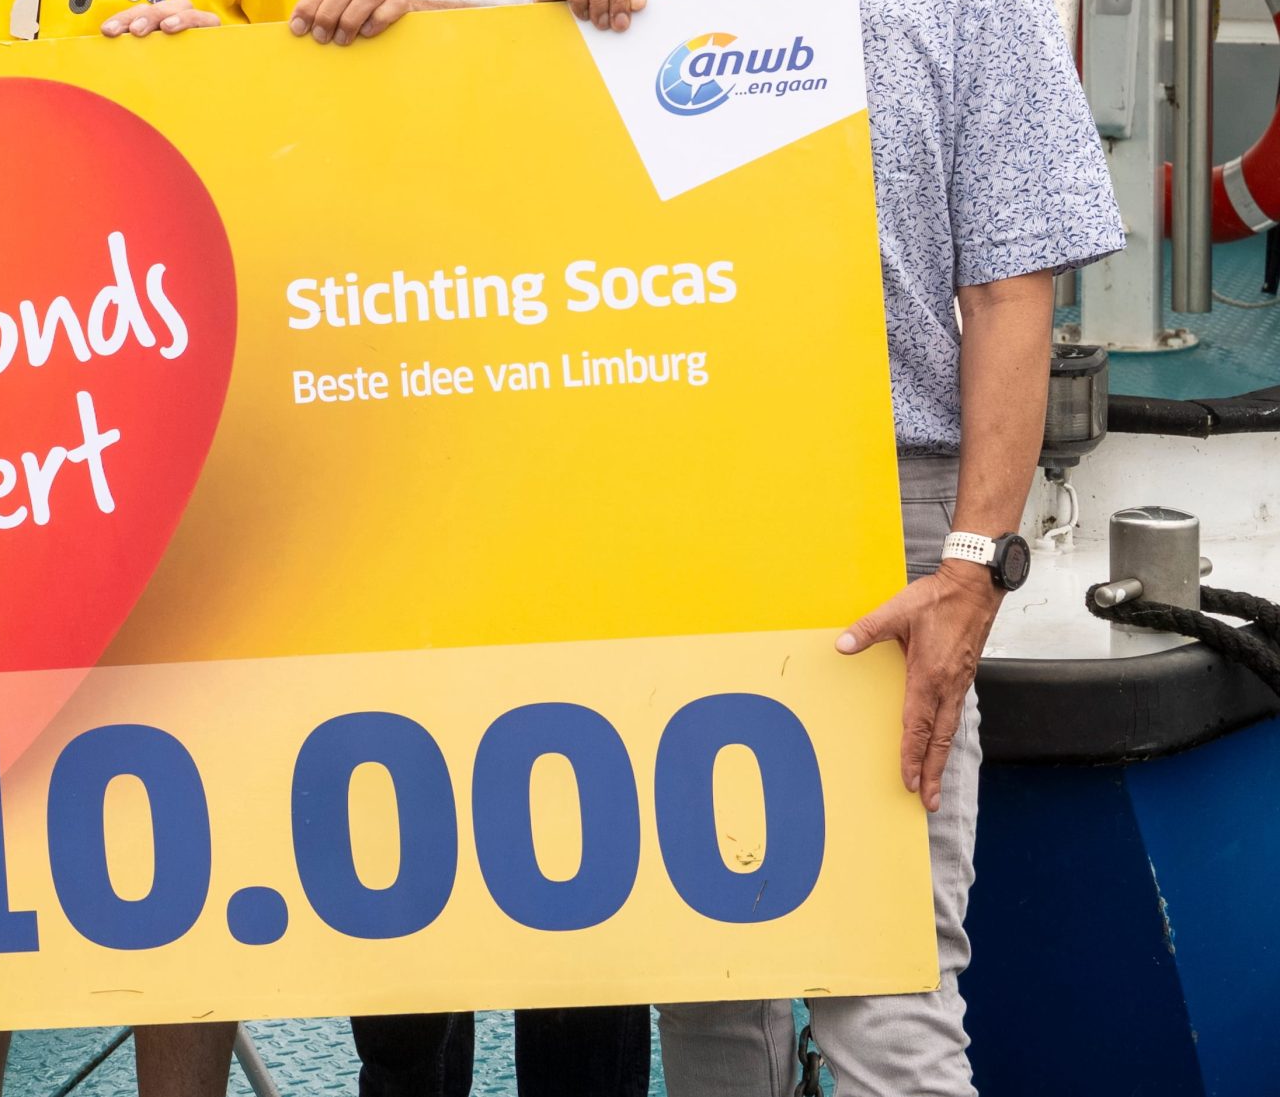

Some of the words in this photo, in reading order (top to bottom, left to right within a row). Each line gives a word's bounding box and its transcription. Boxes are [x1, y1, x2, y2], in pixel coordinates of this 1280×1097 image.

[688, 35, 815, 78] anwb
[775, 77, 828, 97] gaan
[285, 265, 548, 330] Stichting
[564, 259, 737, 313] Socas
[292, 367, 389, 404] Beste
[400, 361, 474, 397] idee
[484, 361, 550, 392] van
[562, 347, 709, 387] Limburg
